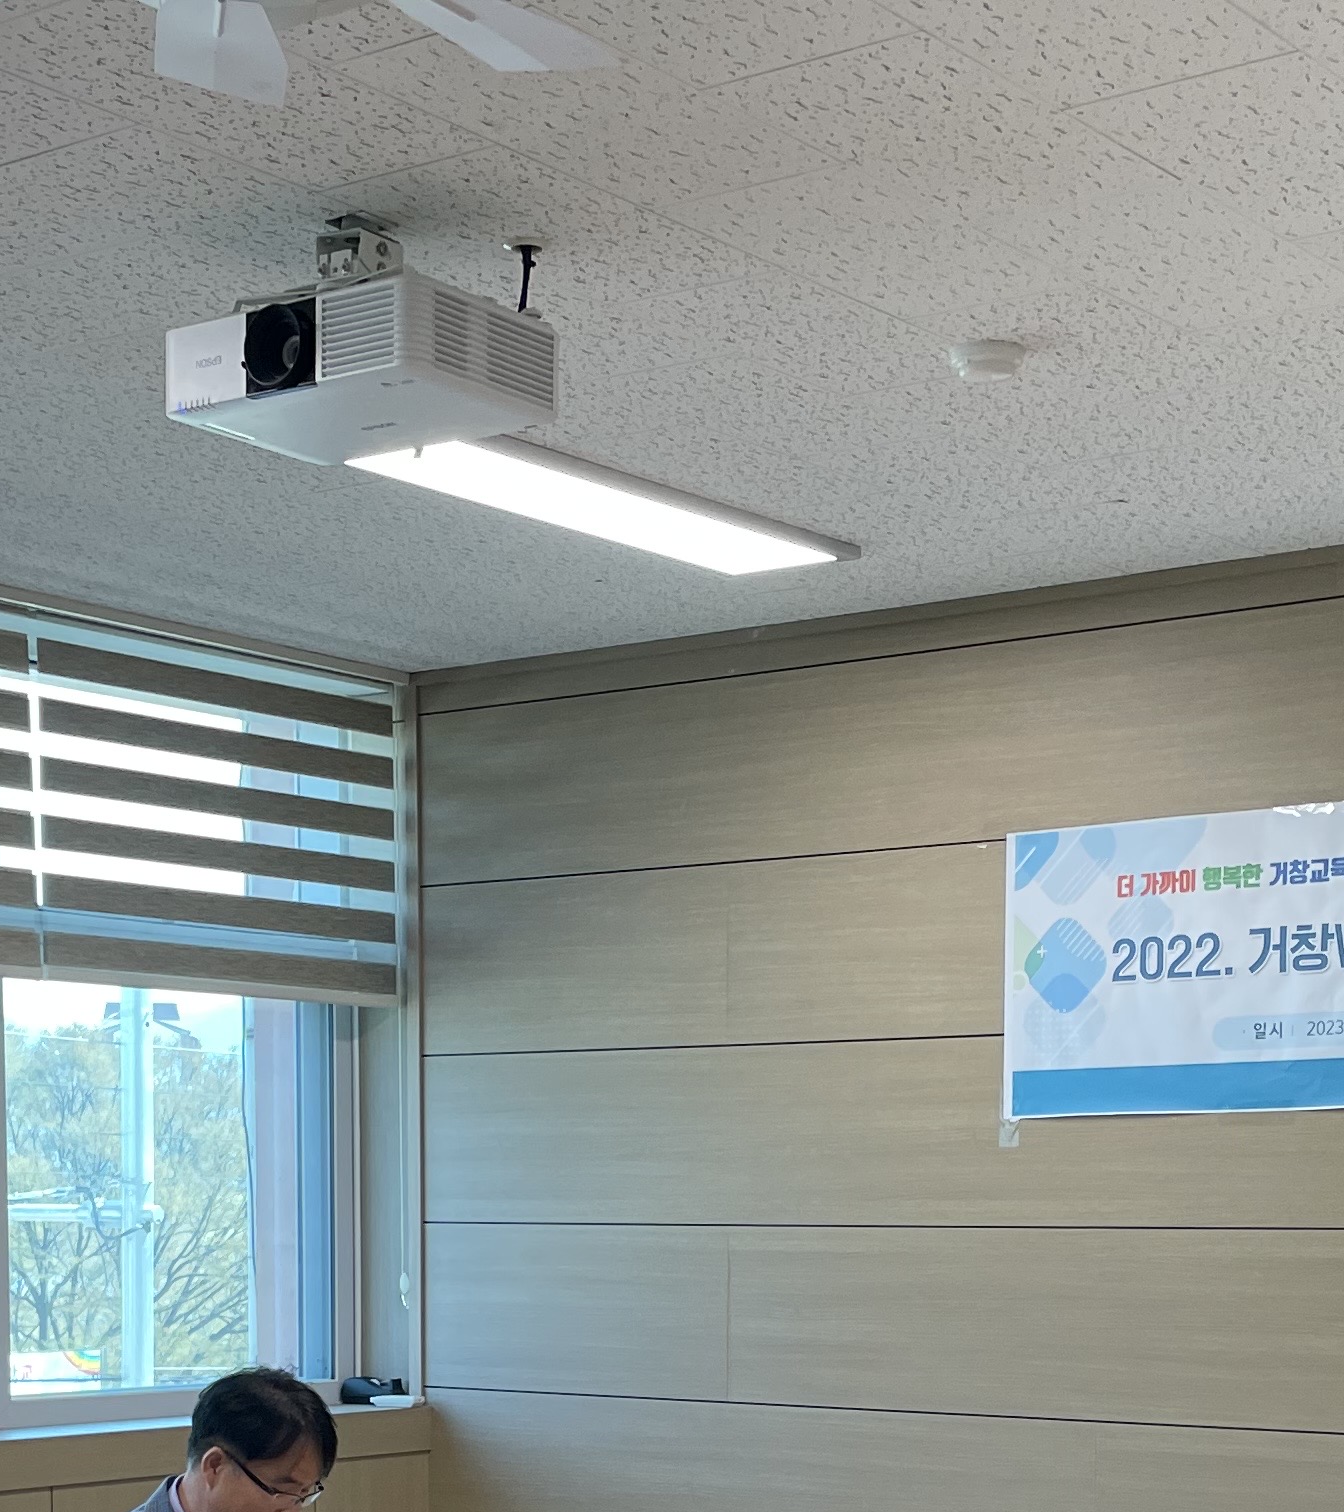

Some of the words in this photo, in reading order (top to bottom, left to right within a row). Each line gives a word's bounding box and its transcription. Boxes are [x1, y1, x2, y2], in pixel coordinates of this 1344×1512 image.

[195, 355, 222, 369] EPSON
[1116, 874, 1135, 898] 더
[1139, 868, 1197, 896] 가까이
[1202, 863, 1263, 891] 행복한
[1111, 932, 1234, 982] 2022.
[1252, 1021, 1283, 1040] 일시
